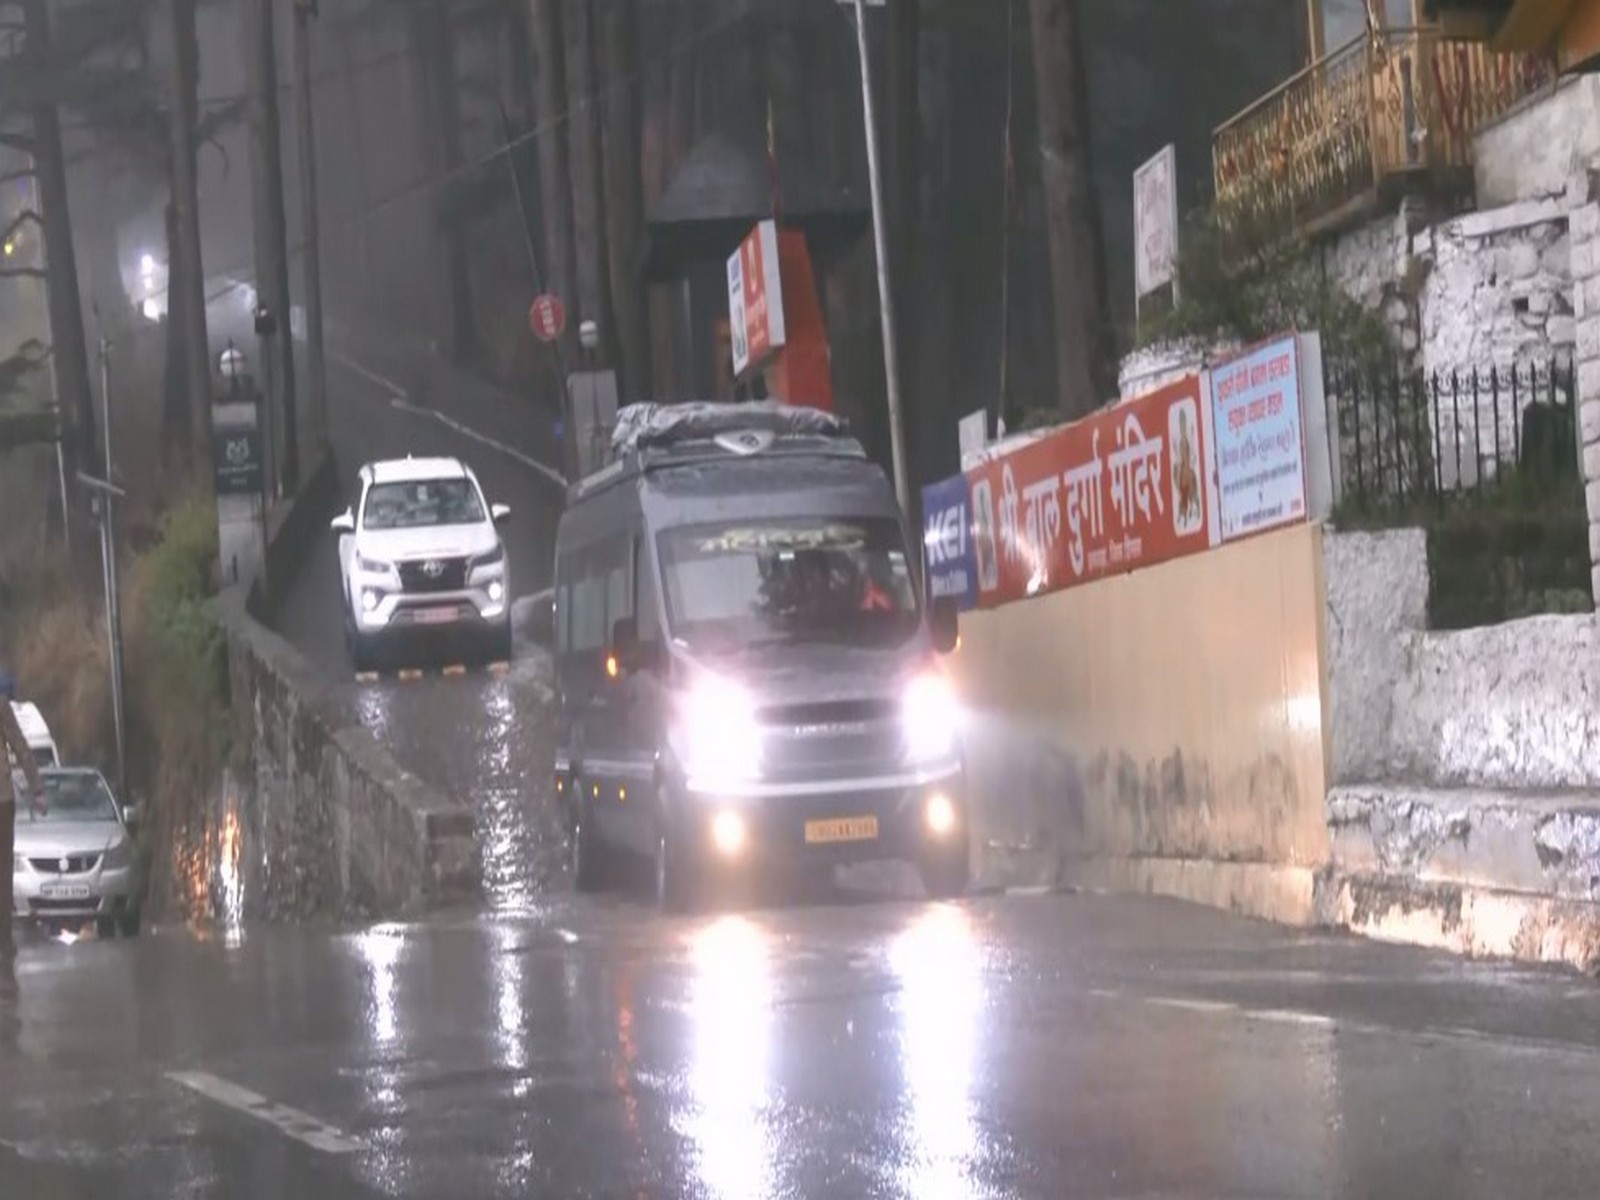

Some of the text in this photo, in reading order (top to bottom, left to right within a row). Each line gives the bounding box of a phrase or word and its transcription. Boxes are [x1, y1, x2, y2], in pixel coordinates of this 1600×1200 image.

[925, 504, 966, 566] KEI
[1063, 427, 1105, 577] दुर्गा
[1107, 412, 1164, 528] मंदिर
